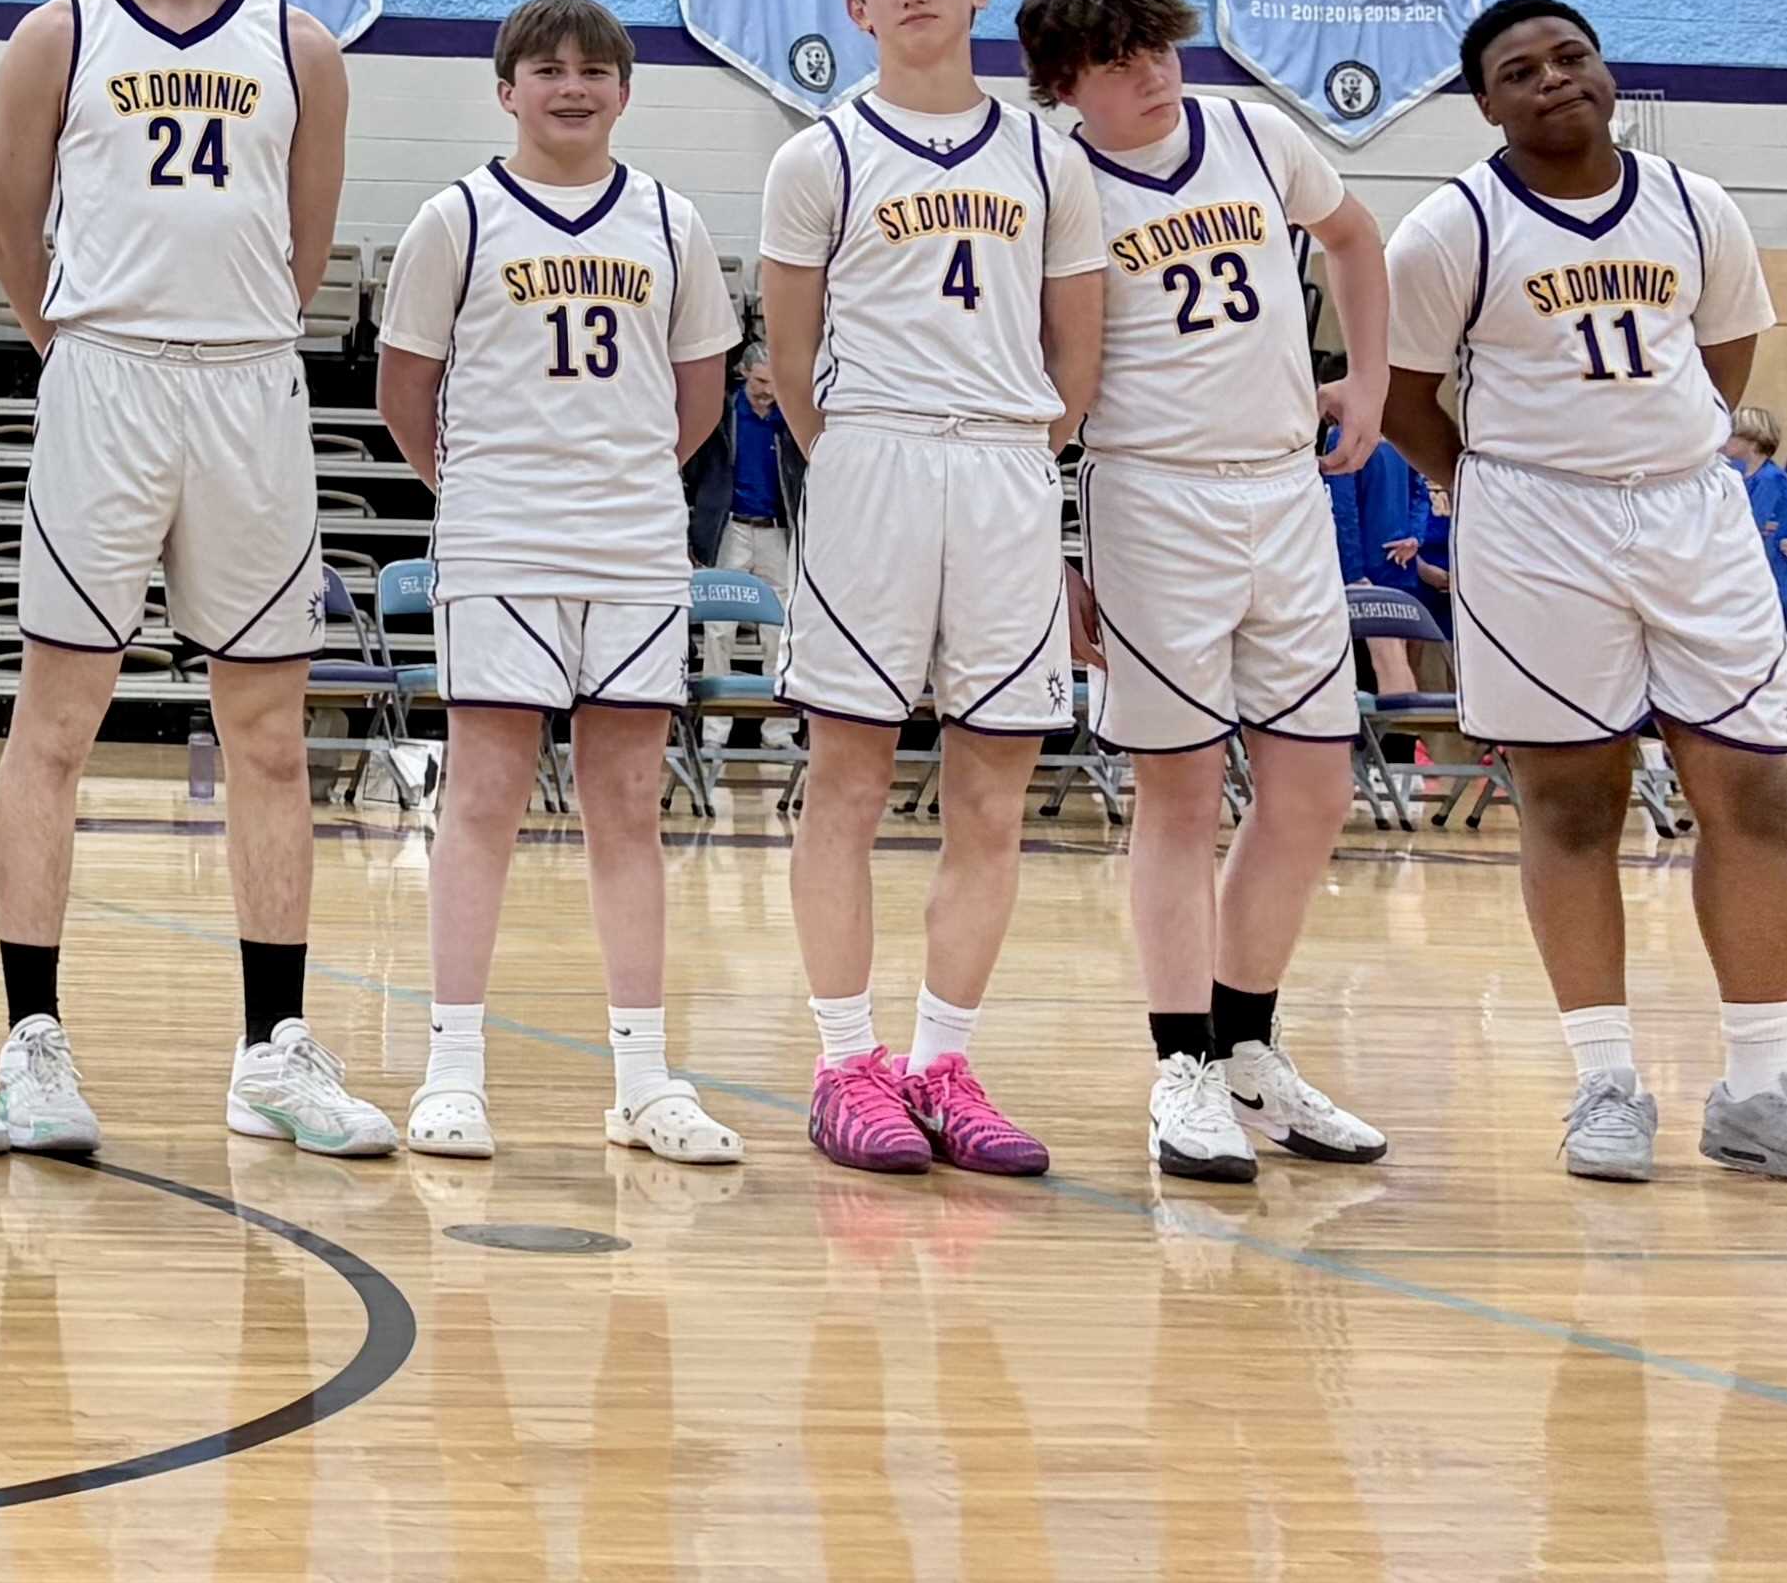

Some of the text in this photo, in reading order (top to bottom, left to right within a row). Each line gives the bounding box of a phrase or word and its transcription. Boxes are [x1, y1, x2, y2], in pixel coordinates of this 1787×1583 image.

[147, 116, 230, 190] 24
[940, 239, 982, 312] 4
[1162, 251, 1261, 336] 23
[545, 303, 620, 381] 13
[1575, 309, 1654, 381] 11
